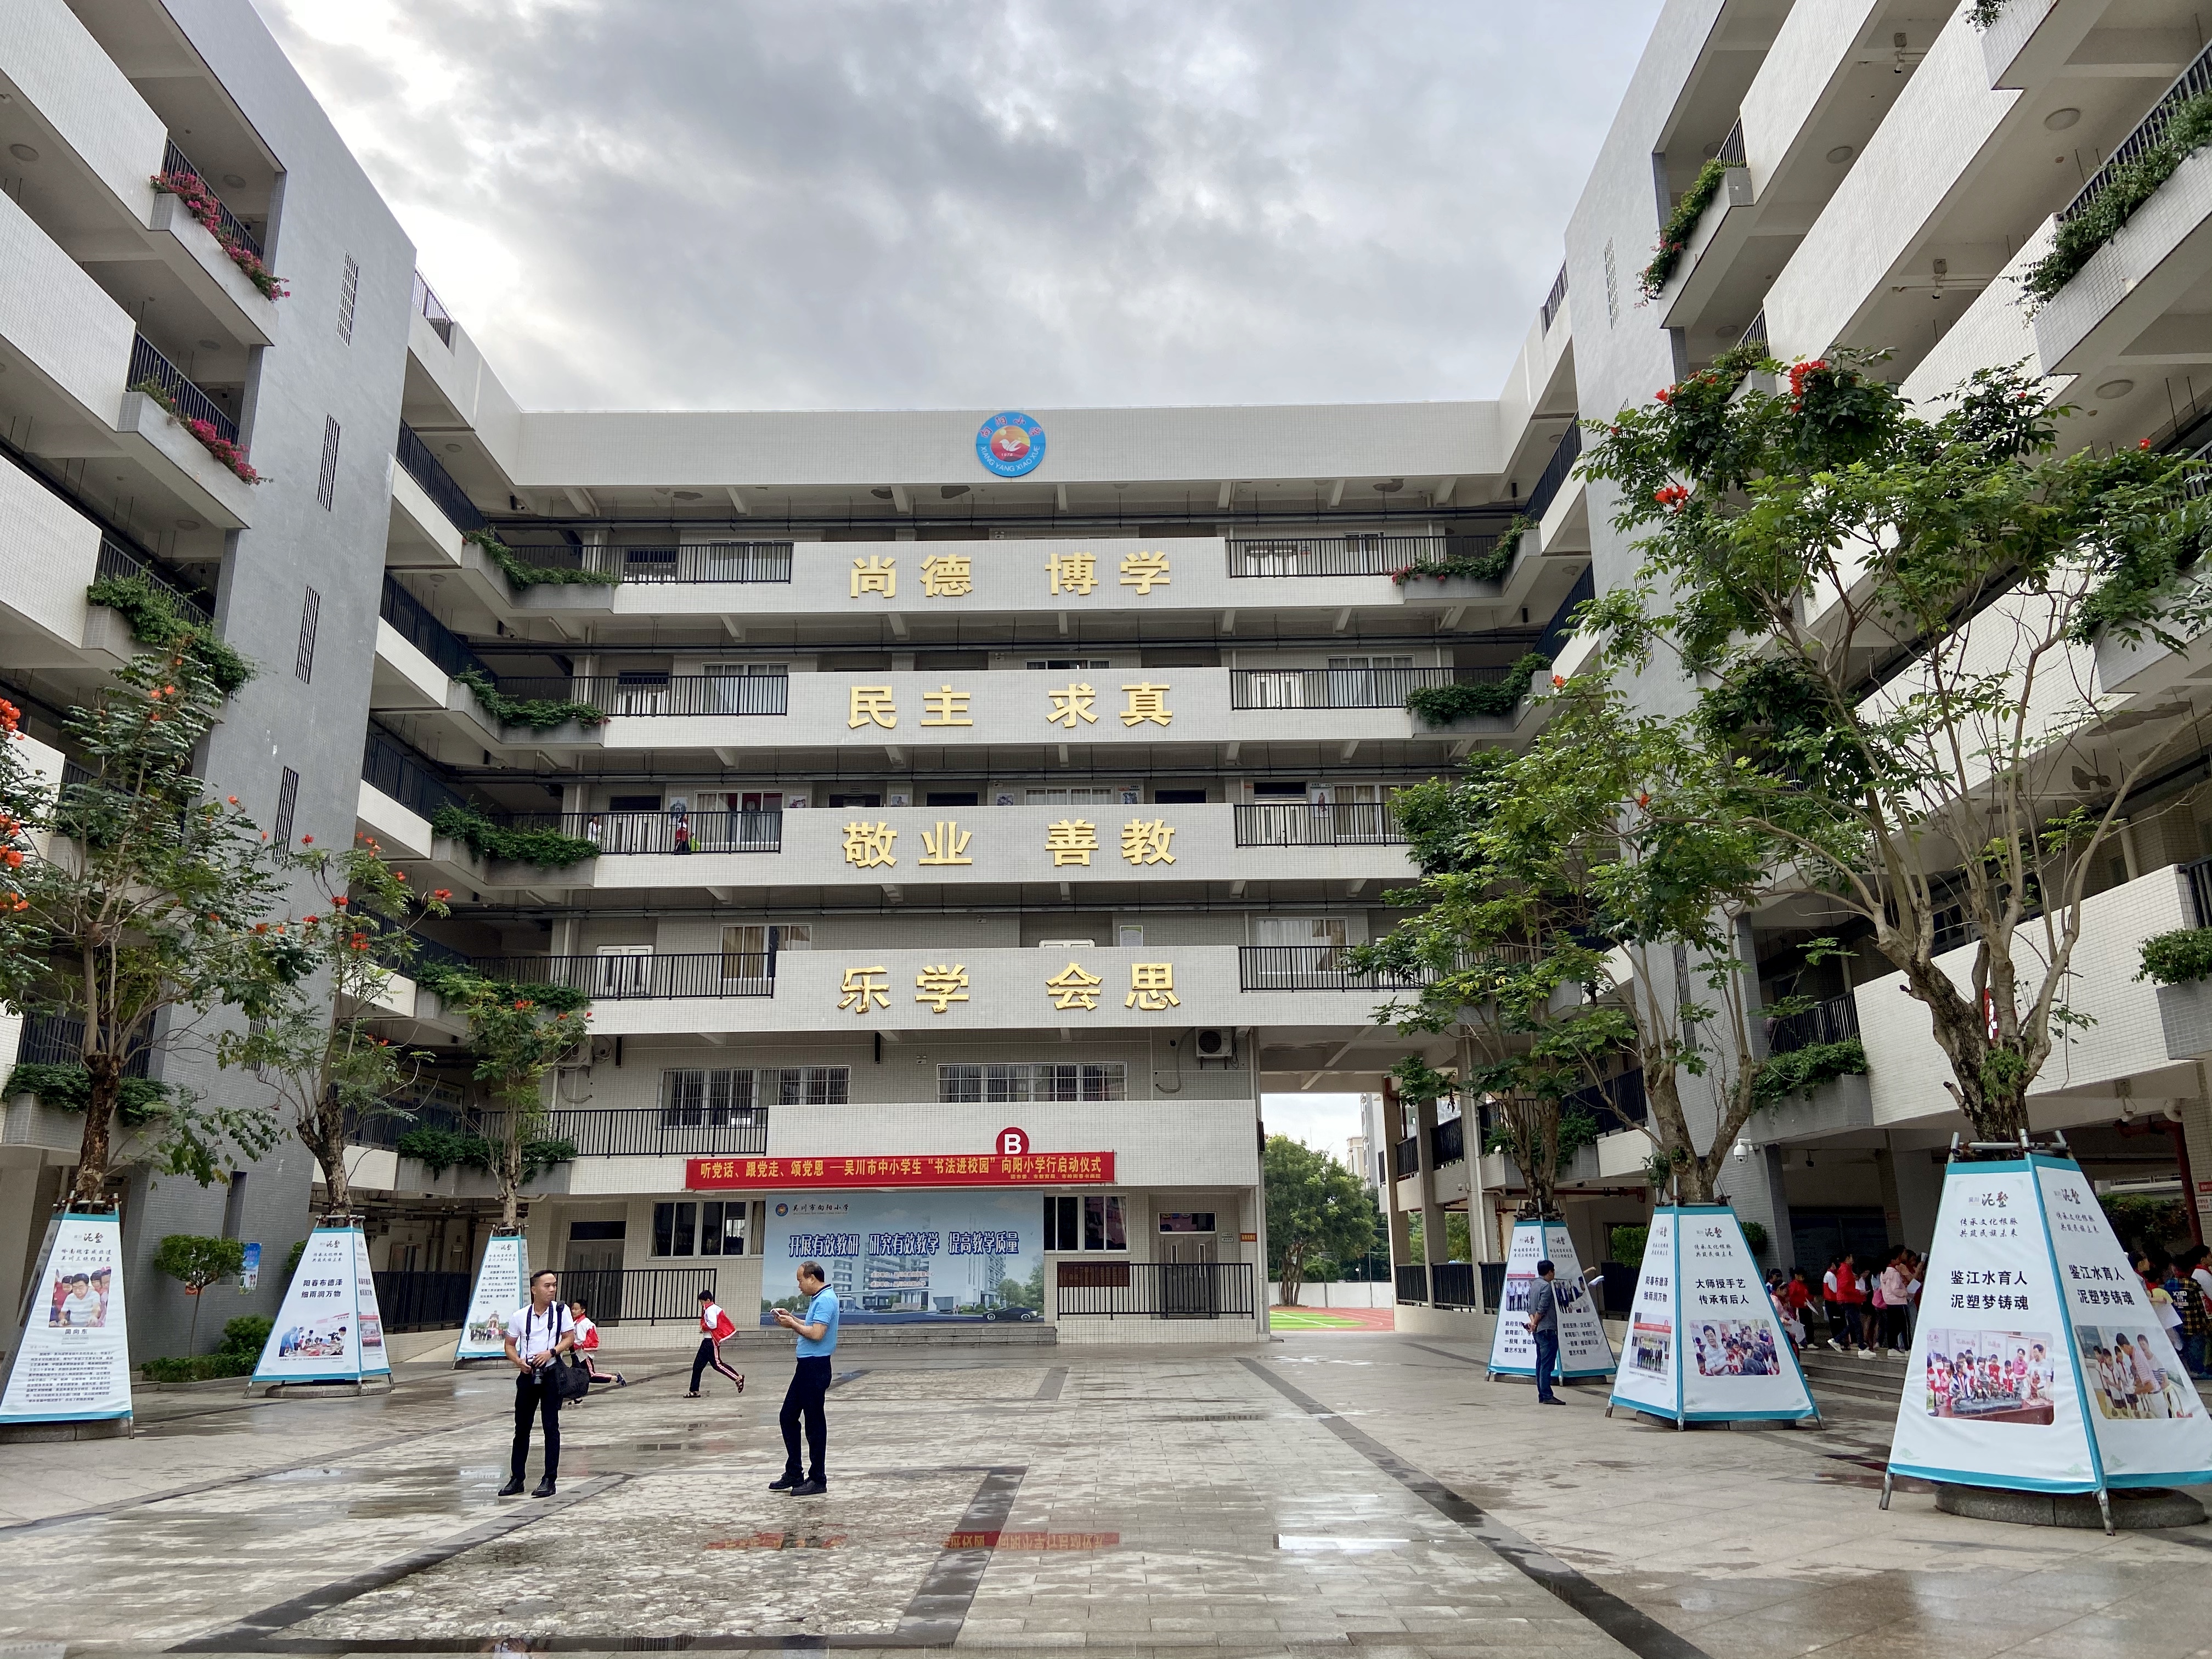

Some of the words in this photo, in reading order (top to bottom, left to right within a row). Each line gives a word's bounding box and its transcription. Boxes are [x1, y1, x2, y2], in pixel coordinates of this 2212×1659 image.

[979, 415, 1042, 438] 向阳小学
[980, 445, 996, 466] XIANG
[996, 462, 1015, 472] YANG
[1017, 459, 1032, 471] XIAO
[1030, 445, 1040, 460] XUE
[850, 554, 973, 598] 尚德
[1045, 551, 1170, 595] 博学
[848, 685, 973, 729] 民主
[1046, 682, 1173, 727] 求真
[843, 821, 972, 868] 敬业
[1045, 819, 1175, 866] 善教
[838, 964, 970, 1013] 乐学
[1046, 962, 1181, 1011] 会思
[1004, 1133, 1022, 1154] B
[793, 1203, 848, 1212] 吴川市向阳小学
[1960, 1217, 2018, 1226] 传承文化根脉
[1960, 1228, 2018, 1238] 共筑民族未来
[789, 1234, 860, 1257] 开展有效教研
[868, 1232, 940, 1255] 研究有效教学
[949, 1232, 1019, 1254] 提高教学质量
[1951, 1270, 2028, 1285] 鉴江水育人
[2068, 1264, 2125, 1281] 鉴江水育人
[303, 1278, 343, 1286] 阳春布德泽
[1695, 1278, 1746, 1289] 大师授手艺
[301, 1290, 341, 1298] 细雨润万物
[1699, 1294, 1750, 1305] 传承有后人
[1951, 1294, 2029, 1310] 泥塑梦铸魂
[2077, 1288, 2135, 1305] 泥塑梦铸魂
